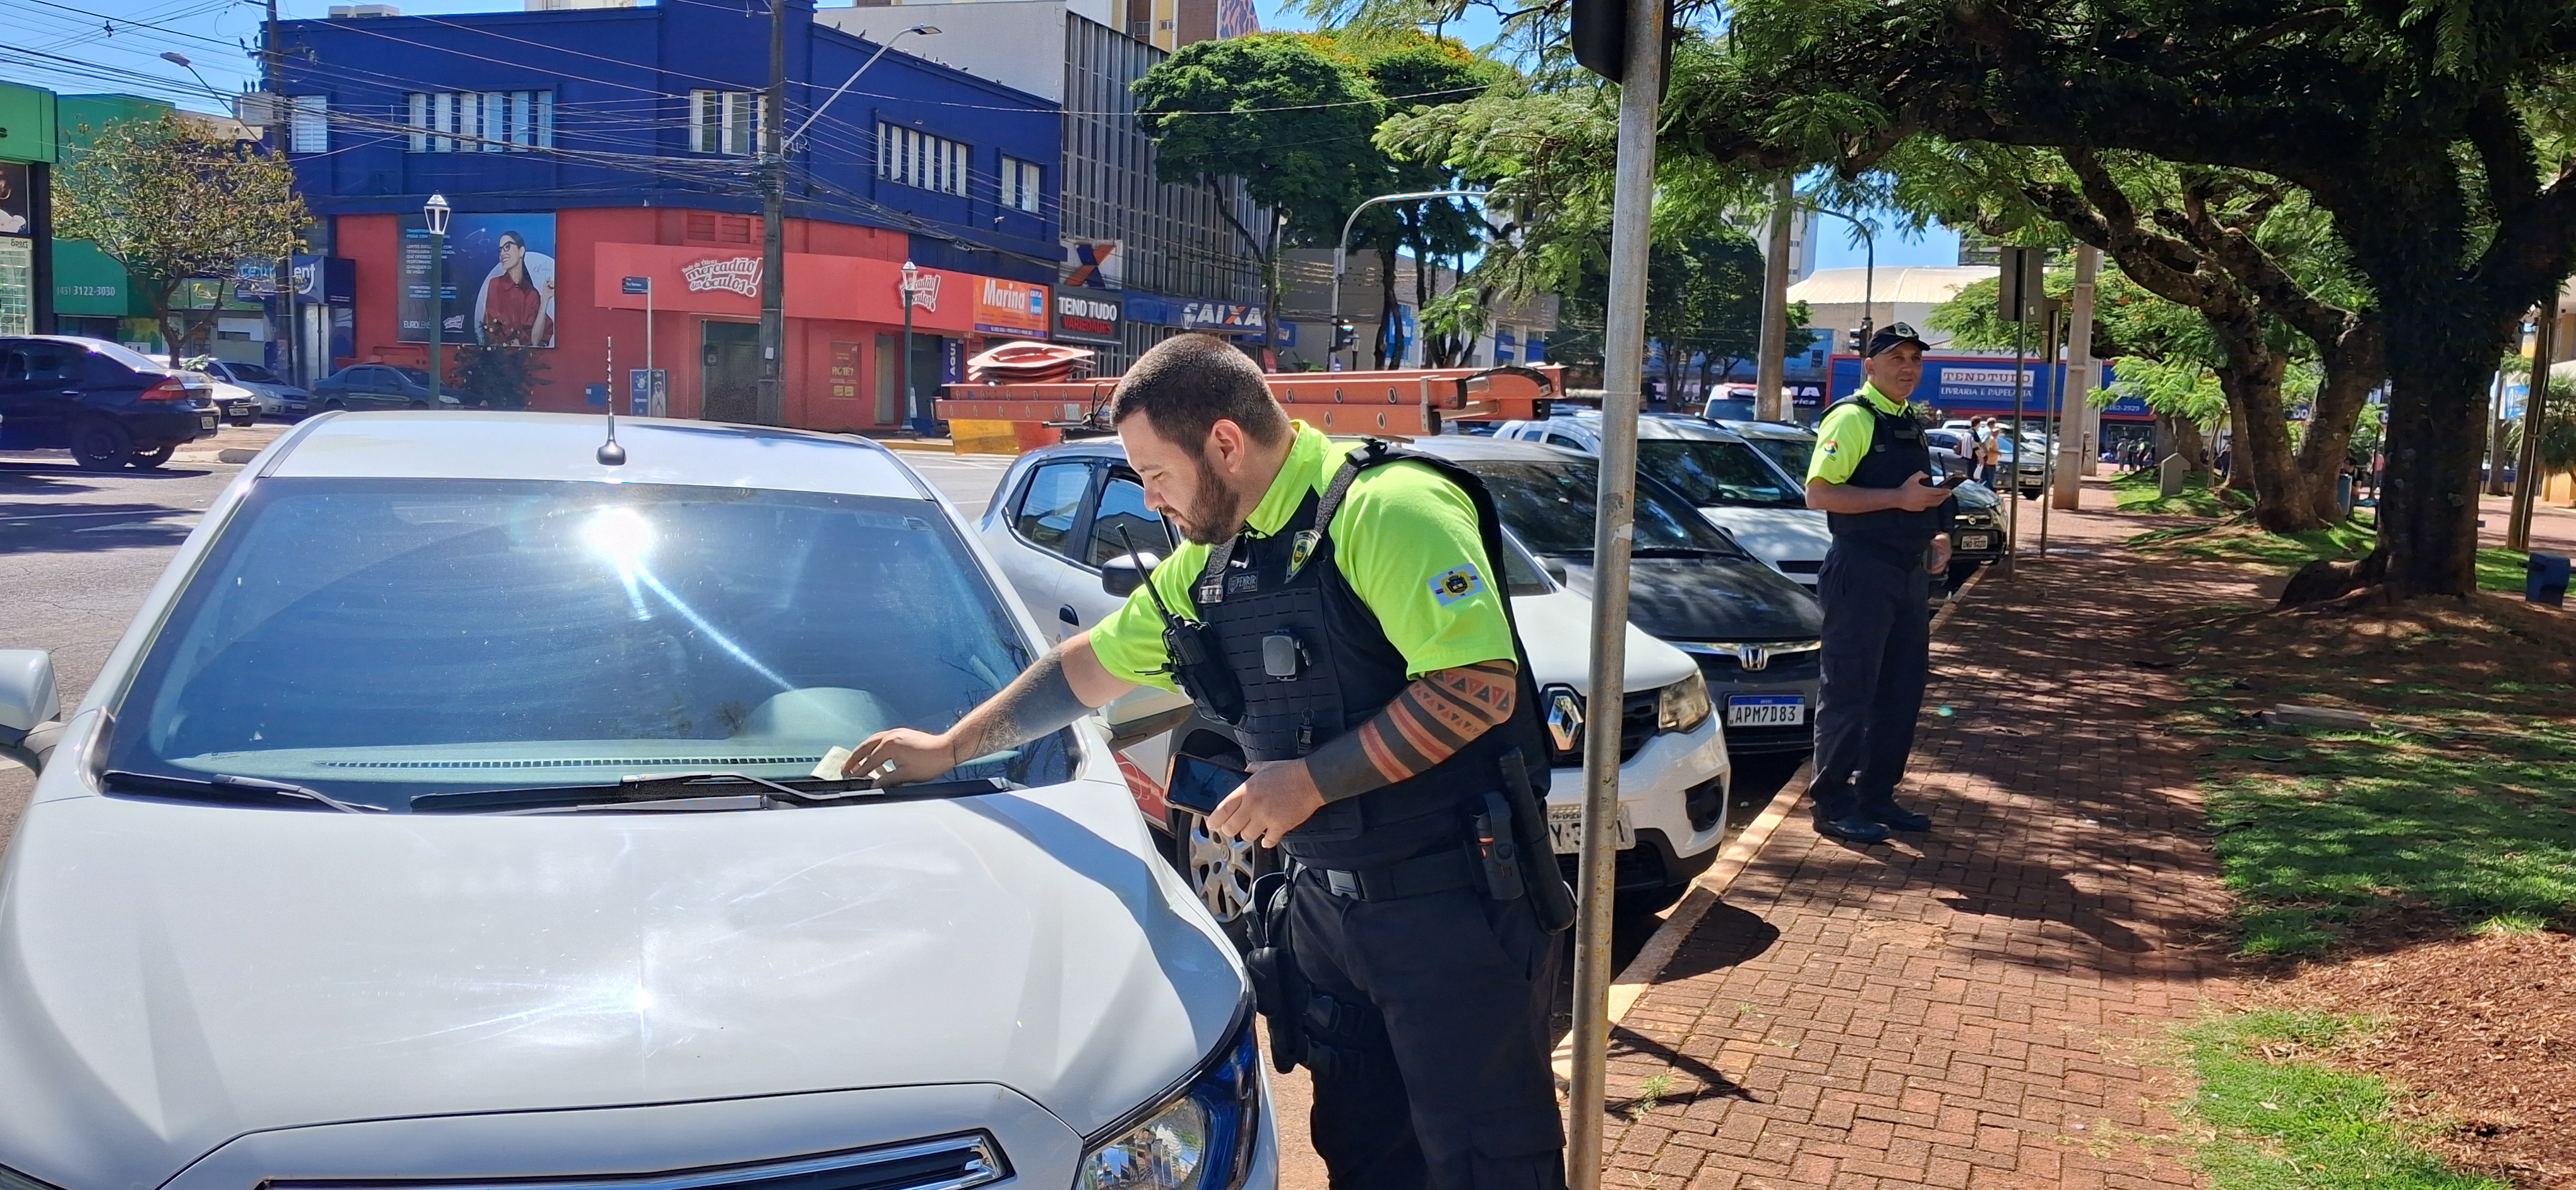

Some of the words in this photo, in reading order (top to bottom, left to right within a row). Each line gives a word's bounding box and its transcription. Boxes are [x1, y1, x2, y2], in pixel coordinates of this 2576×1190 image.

[73, 285, 116, 296] 3122-3030
[982, 279, 1025, 310] Marina
[1058, 296, 1087, 317] TEND
[1087, 301, 1118, 322] TUDO
[1183, 303, 1262, 327] CAIXA
[1063, 317, 1112, 335] VARIEDADES
[1941, 387, 1977, 395] LIVRARIA
[1988, 388, 2032, 397] PAPELAIA
[1735, 706, 1796, 723] APM7D83
